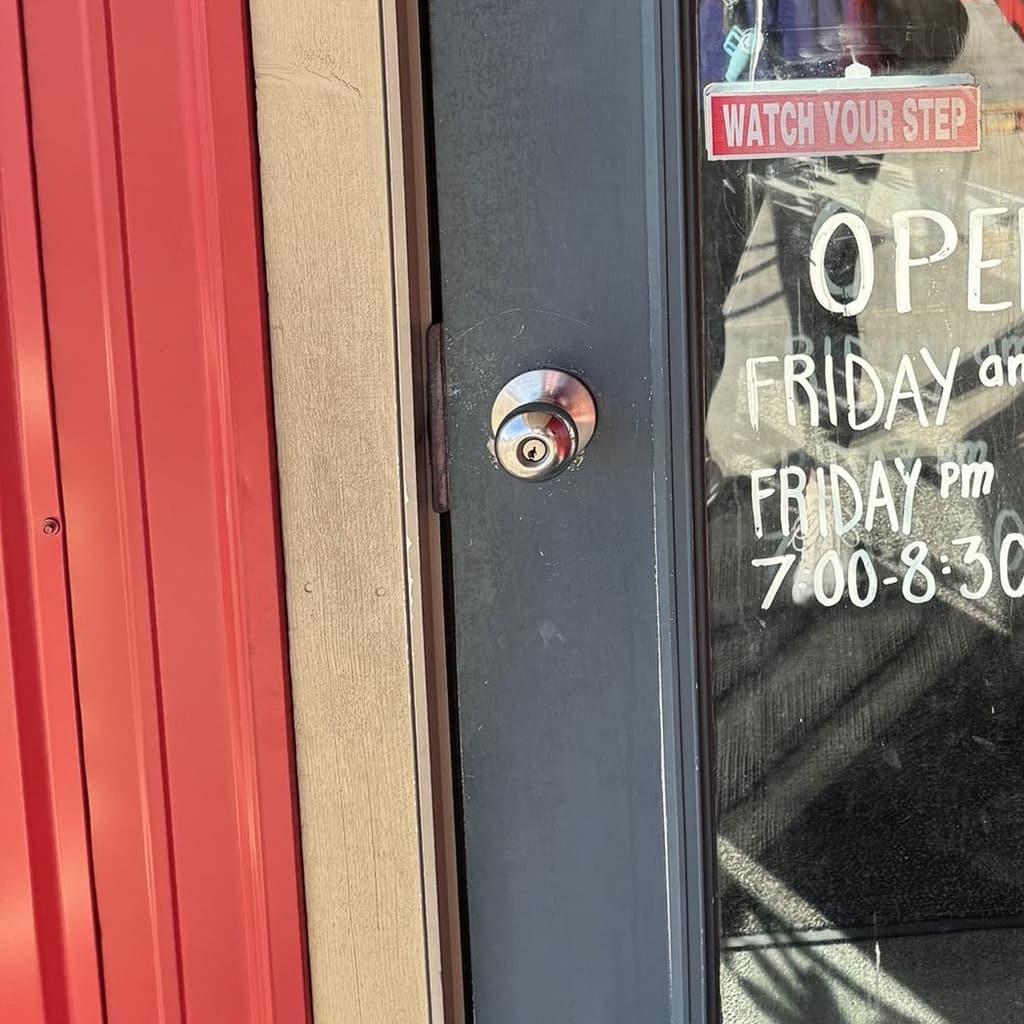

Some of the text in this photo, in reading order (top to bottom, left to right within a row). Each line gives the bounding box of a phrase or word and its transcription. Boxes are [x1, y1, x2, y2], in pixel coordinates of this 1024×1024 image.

[722, 97, 966, 147] WATCH YOUR STEP
[745, 346, 960, 431] FRIDAY
[750, 458, 995, 538] FRIDAY pm
